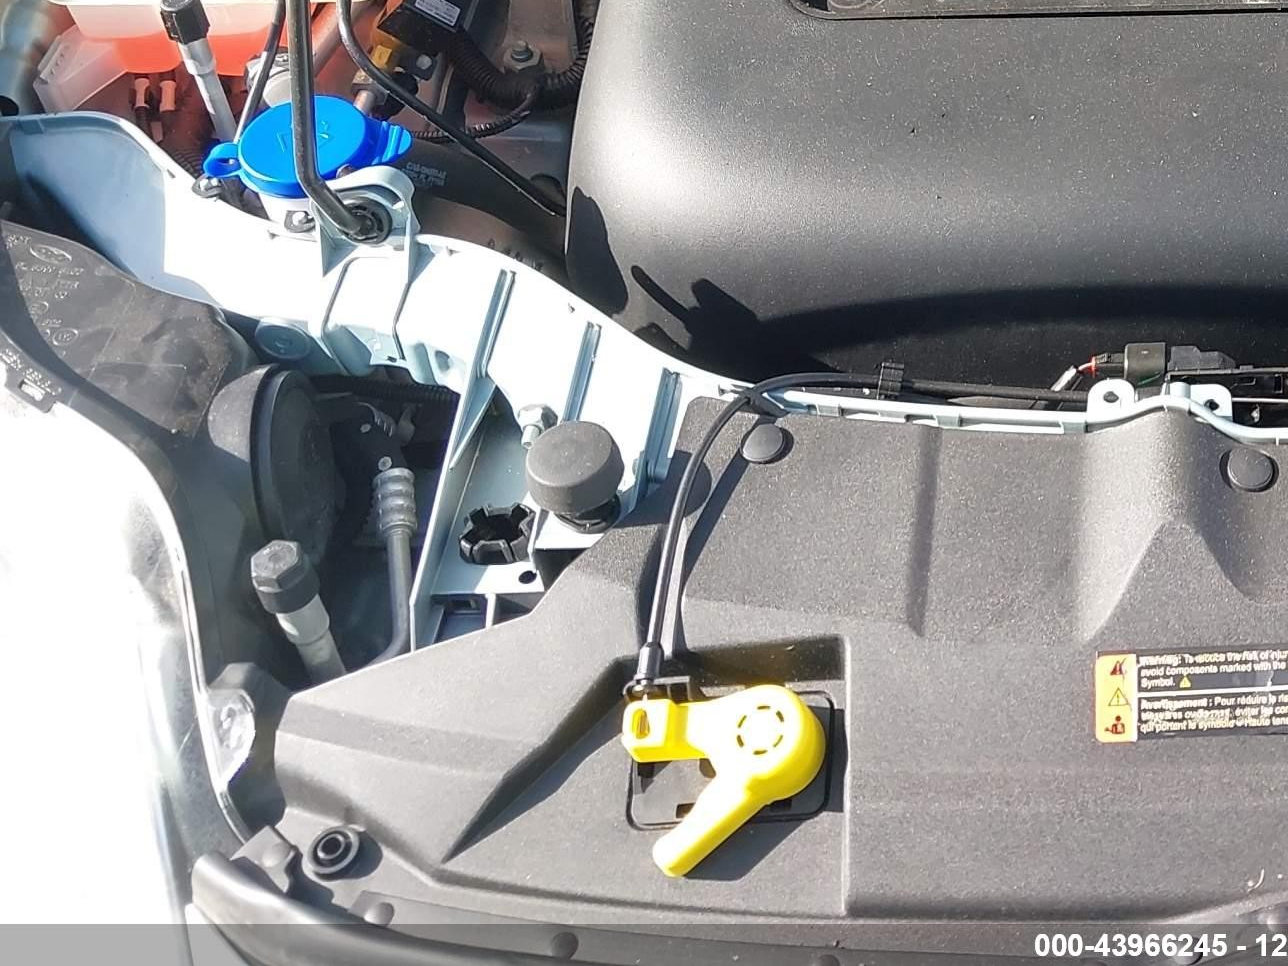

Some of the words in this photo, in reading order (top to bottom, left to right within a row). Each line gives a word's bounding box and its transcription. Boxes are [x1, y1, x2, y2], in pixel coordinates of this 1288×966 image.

[1140, 667, 1164, 677] avoid
[1166, 665, 1219, 677] components
[1220, 663, 1252, 673] marked
[1253, 661, 1272, 671] with
[1273, 660, 1287, 670] the
[1140, 677, 1176, 689] Symbol.
[1214, 696, 1236, 706] Pour
